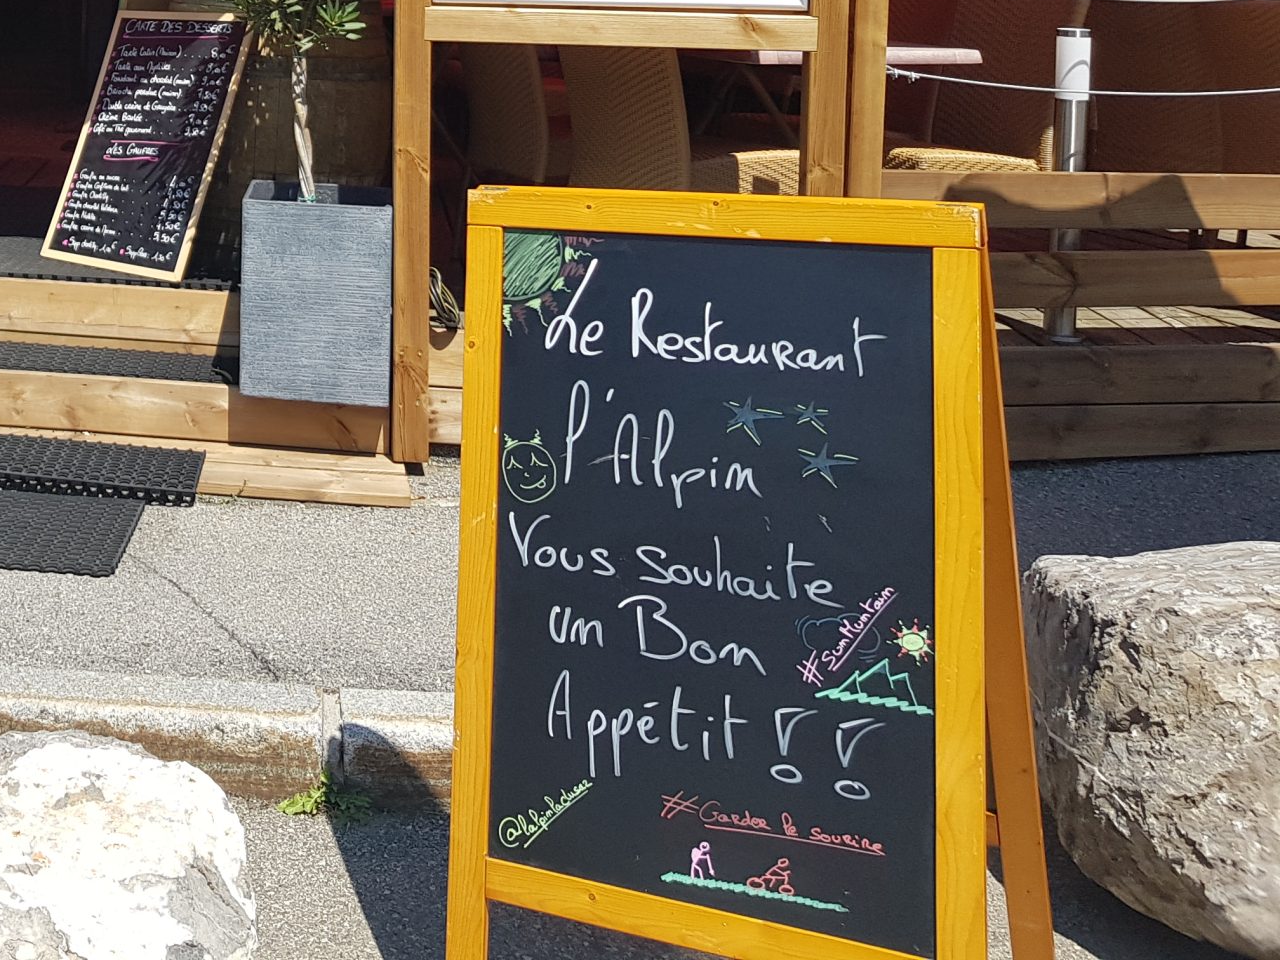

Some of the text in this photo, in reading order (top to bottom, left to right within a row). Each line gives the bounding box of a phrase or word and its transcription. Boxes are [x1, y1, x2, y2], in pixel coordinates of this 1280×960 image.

[160, 22, 182, 33] DES
[185, 22, 234, 34] DESSERTS
[544, 258, 887, 377] Le Restaurant
[507, 512, 615, 575] Vous
[617, 593, 767, 677] Bon
[547, 669, 750, 778] Appétit
